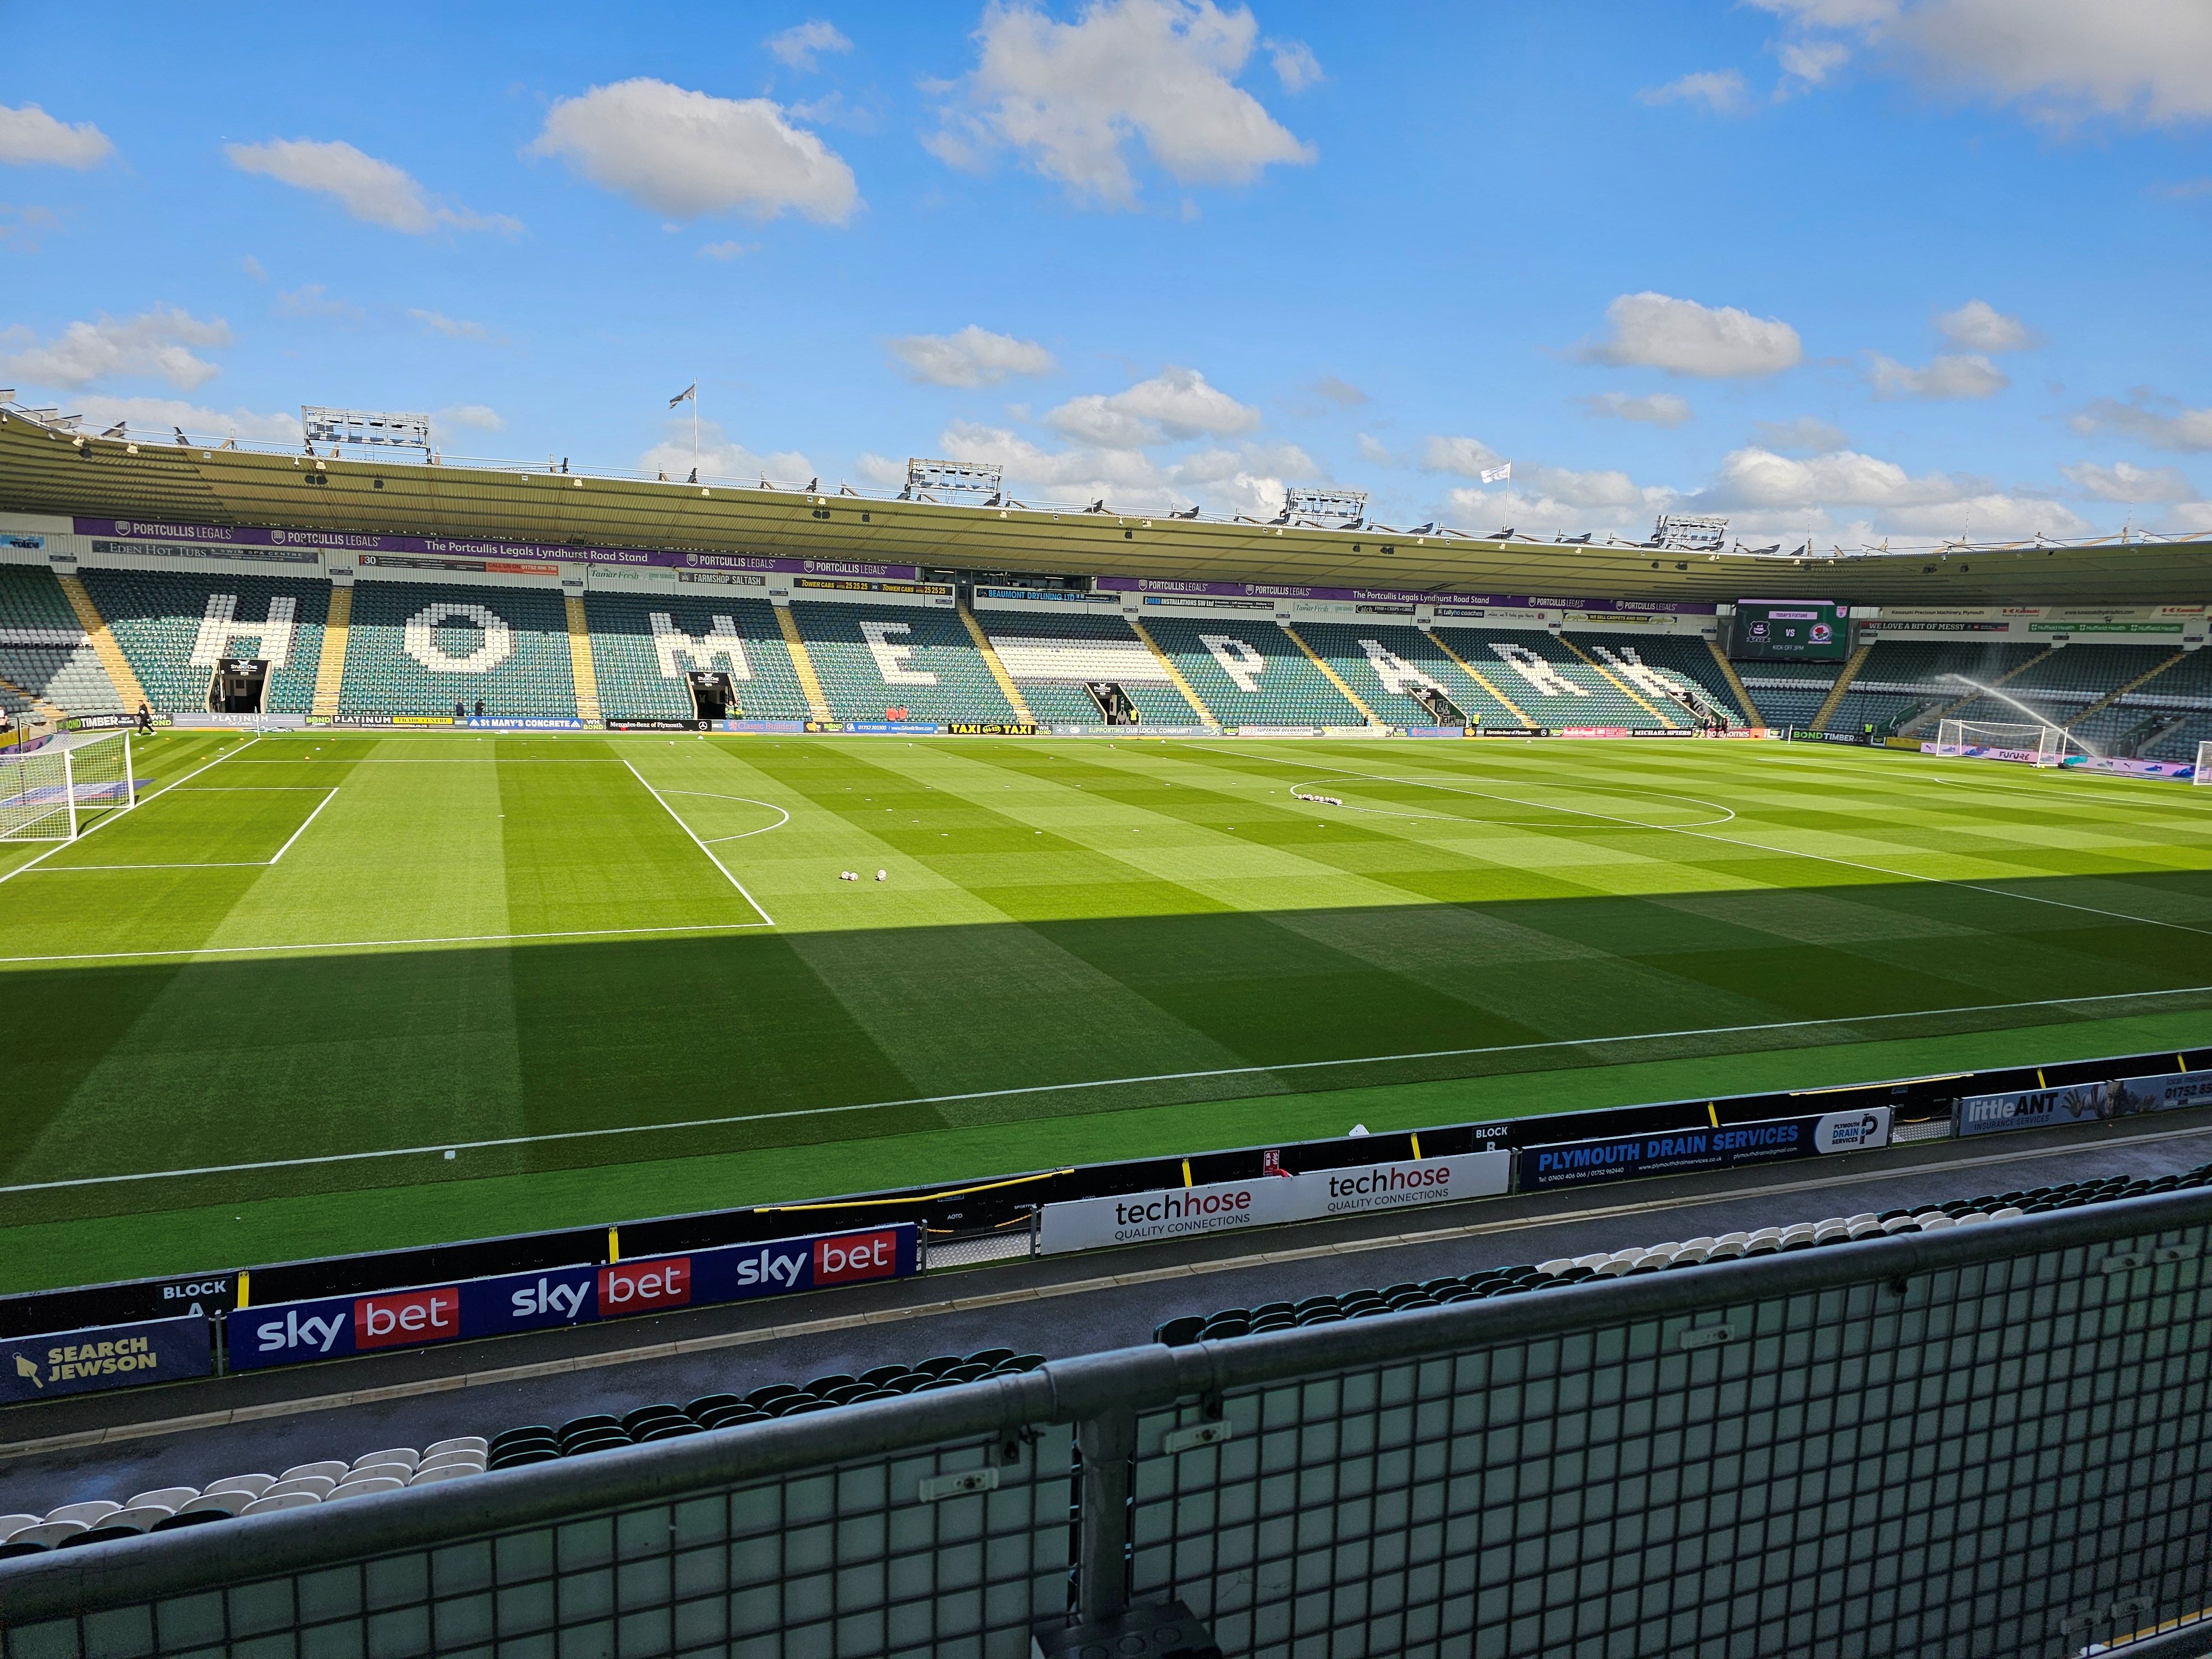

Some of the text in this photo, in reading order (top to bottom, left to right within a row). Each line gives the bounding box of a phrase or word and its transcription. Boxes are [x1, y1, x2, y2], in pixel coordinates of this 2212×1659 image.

[134, 523, 232, 539] PORTCULLIS LEGALS
[288, 532, 378, 546] PORTCULLIS LEGALS
[110, 542, 207, 557] EDEN HOT TUBS
[425, 540, 648, 562] The Portcullis Legals Lyndhurst Road Stand
[700, 556, 774, 568] PORTCULLIS LEGALS
[816, 562, 885, 575] PORTCULLIS LEGALS
[591, 570, 639, 580] Tamar Fresh
[694, 573, 760, 585] FARMSHOP SALTASH
[801, 580, 821, 588] TOWER
[1149, 581, 1206, 592] PORTCULLIS LEGALS
[988, 589, 1025, 599] BEAUMONT
[1027, 592, 1062, 601] DRYLINING
[1255, 586, 1310, 596] PORTCULLIS LEGALS
[1367, 592, 1397, 601] Portcullis
[1398, 593, 1418, 602] Legals
[1537, 598, 1566, 606] PORTCULLIS
[1625, 602, 1655, 610] PORTCULLIS
[1786, 629, 1795, 637] VS
[81, 715, 118, 728] TIMBER
[951, 724, 981, 734] TAXI
[1003, 725, 1032, 734] TAXI
[1793, 731, 1823, 739] BOND
[1823, 733, 1854, 742] TIMBER
[1968, 1092, 2059, 1122] littleANT
[1834, 1121, 1860, 1130] PLYMOUTH
[1974, 1114, 2049, 1131] INSURANCE SERVICES
[1476, 1126, 1508, 1139] BLOCK
[1833, 1128, 1859, 1138] DRAIN
[1832, 1136, 1858, 1145] SERVICES
[1539, 1125, 1799, 1172] PLYMOUTH DRAIN SERVICES
[1329, 1166, 1450, 1198] techhose
[1327, 1188, 1449, 1212] QUALITY CONNECTIONS
[1115, 1191, 1251, 1225] techhose
[1114, 1213, 1250, 1241] QUALITY CONNECTIONS
[737, 1239, 888, 1287] sky bet
[163, 1280, 227, 1299] BLOCK
[512, 1266, 681, 1318] sky bet
[257, 1297, 448, 1353] sky bet
[48, 1337, 148, 1365] SEARCH
[48, 1352, 157, 1383] JEWSON
